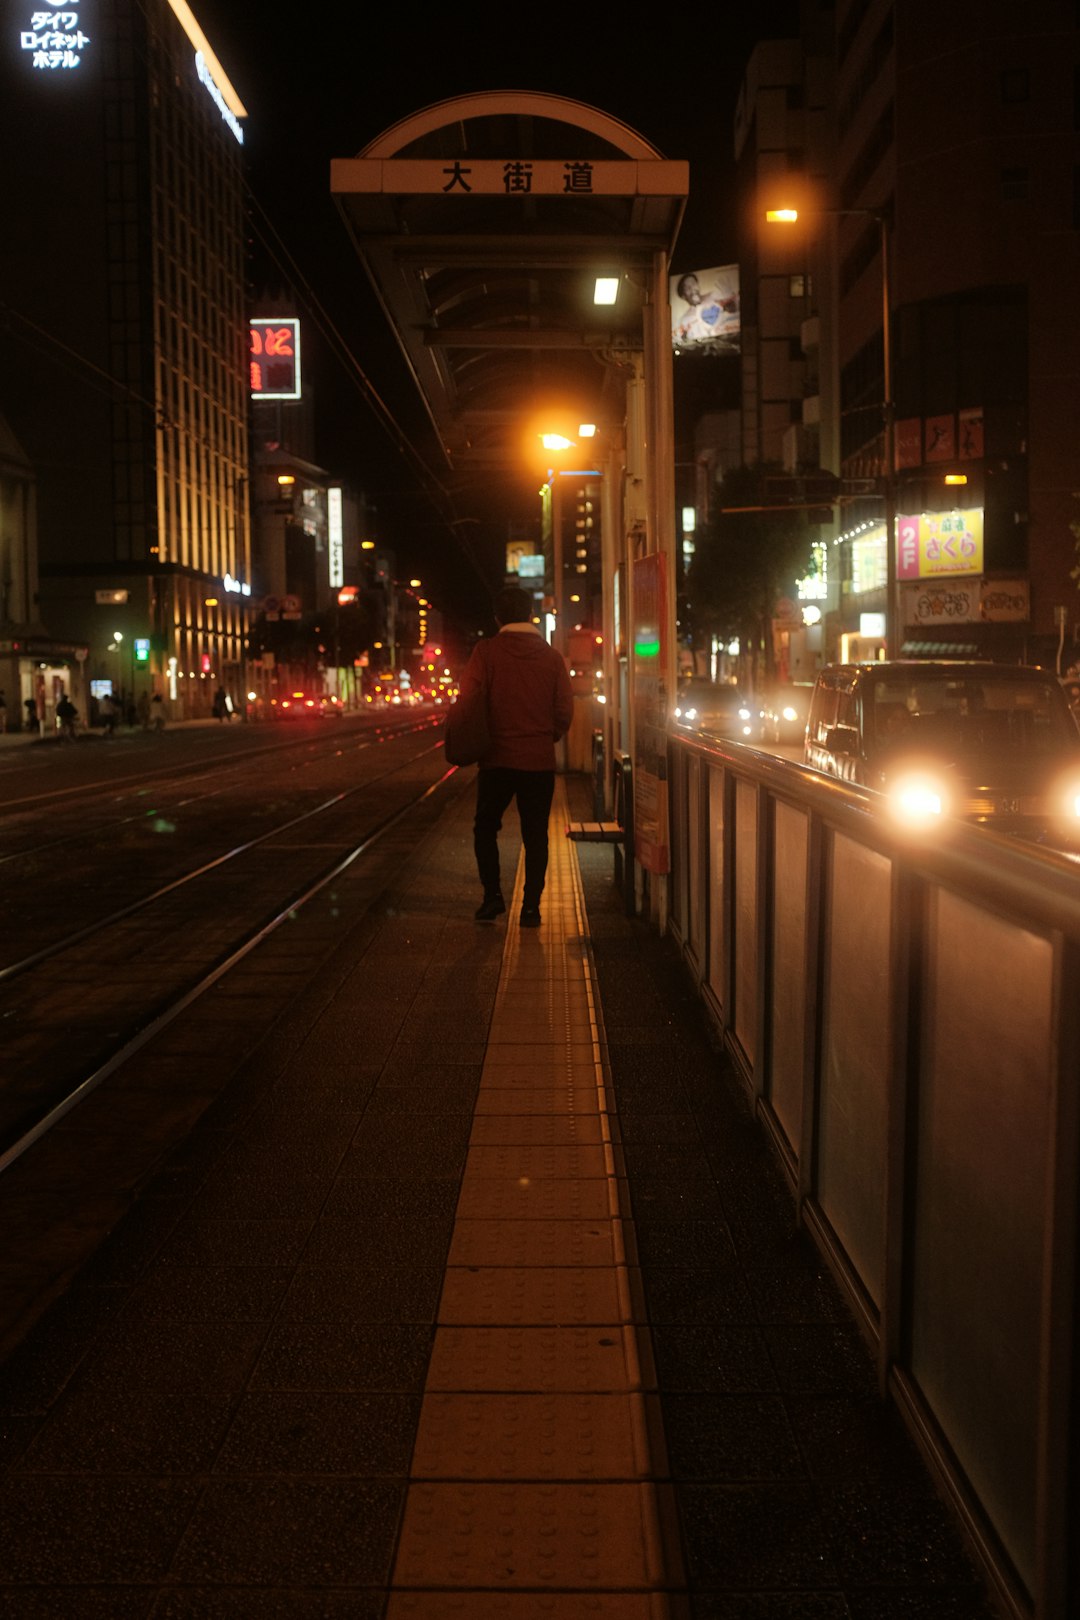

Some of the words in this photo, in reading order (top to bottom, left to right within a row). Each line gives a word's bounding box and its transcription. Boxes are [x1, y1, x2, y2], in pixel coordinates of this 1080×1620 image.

[31, 11, 78, 30] ダイワ
[20, 30, 90, 49] ロイネット
[32, 50, 80, 69] ホテル
[442, 161, 594, 193] 大街道
[902, 526, 916, 571] 2F
[925, 532, 977, 561] さくら
